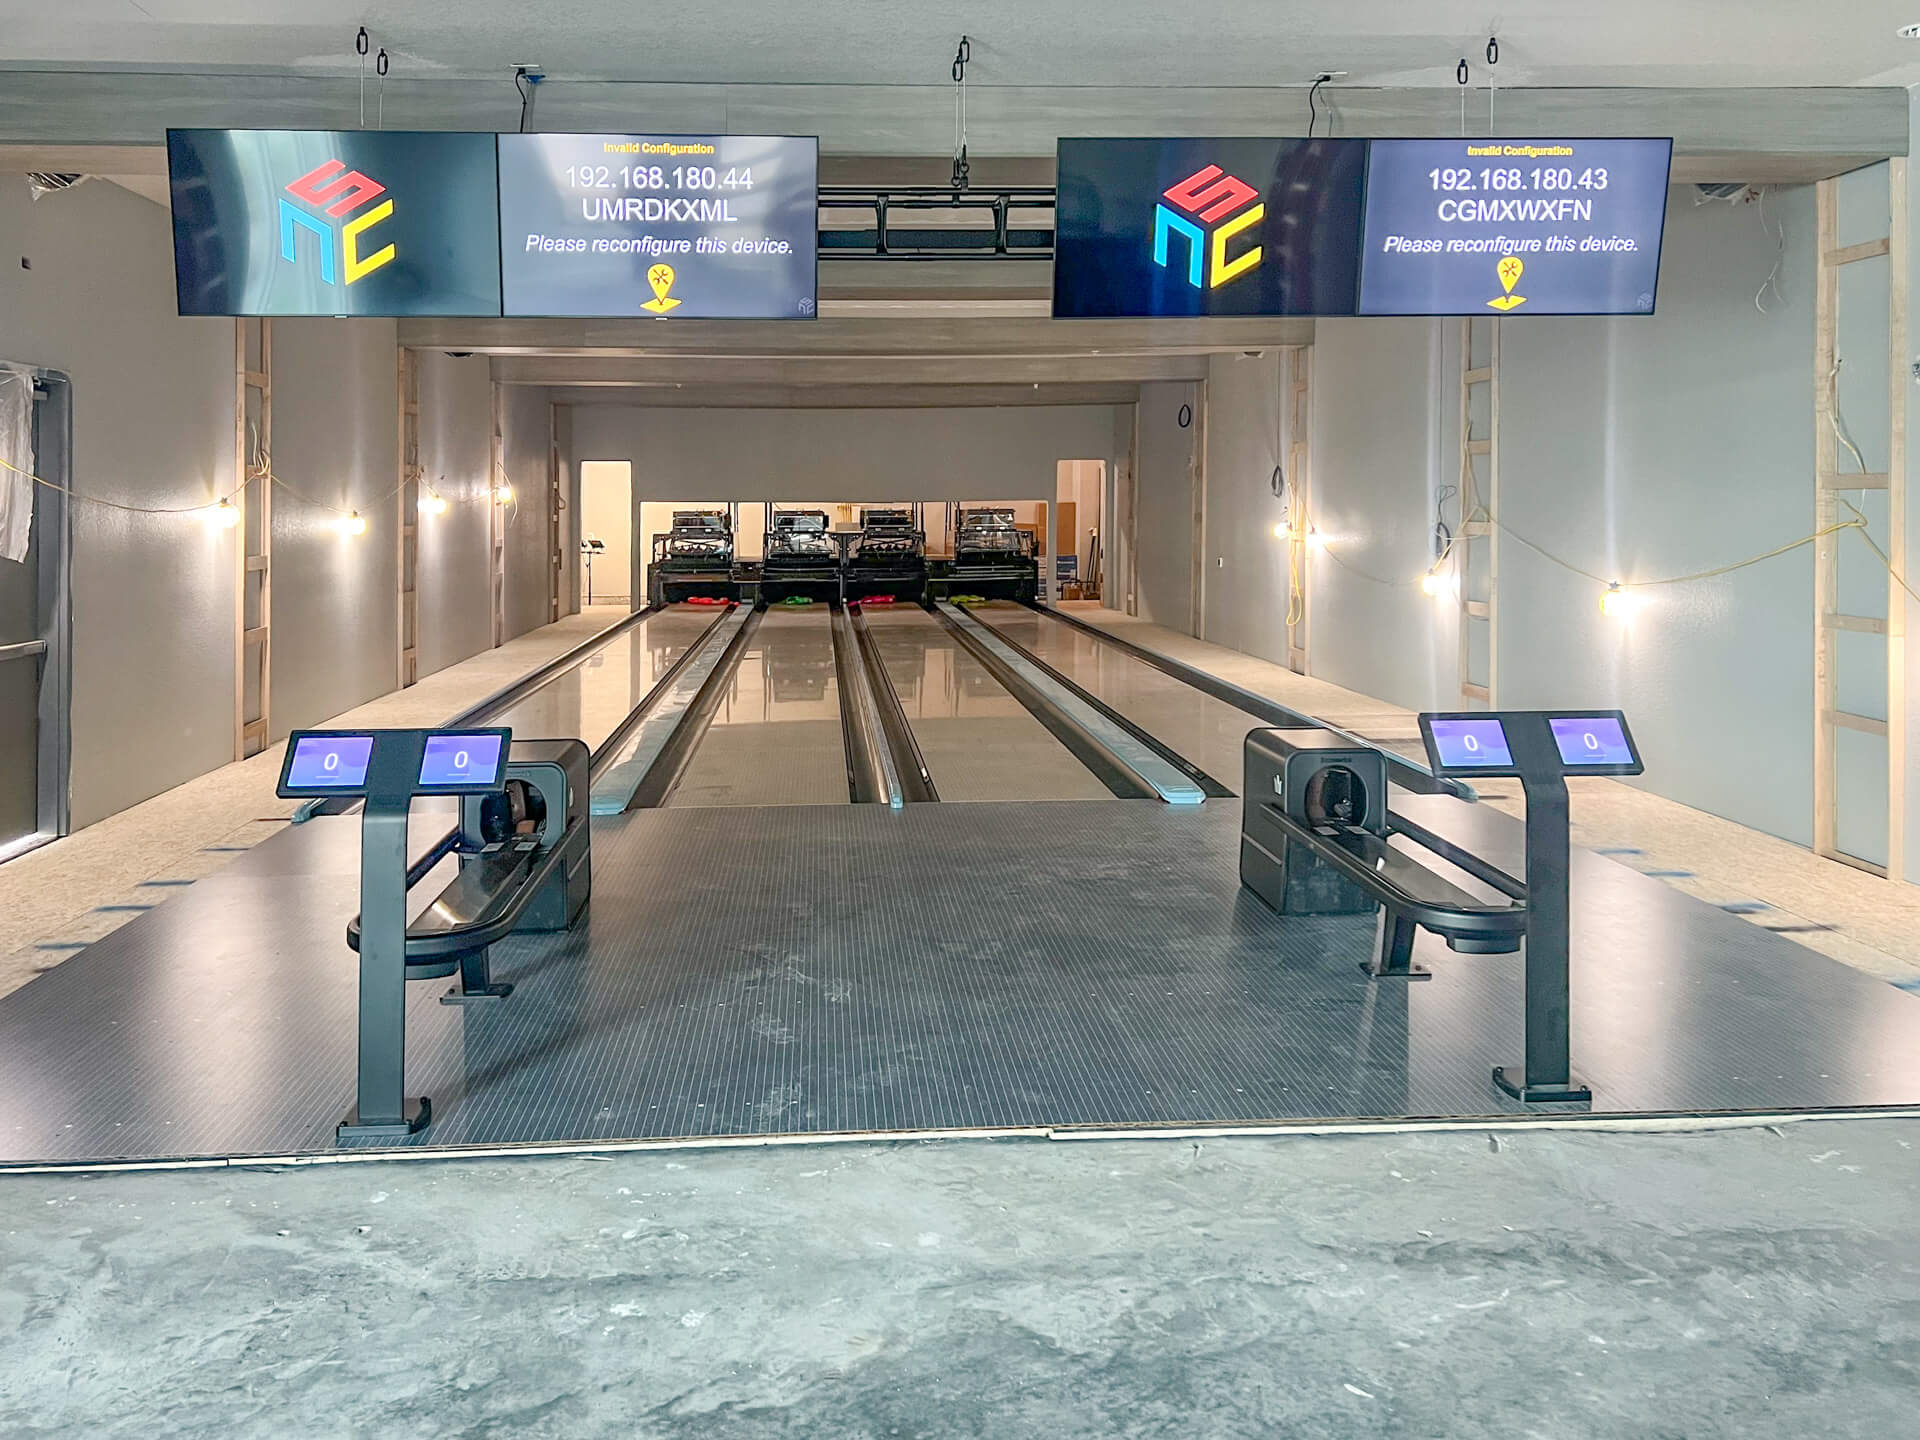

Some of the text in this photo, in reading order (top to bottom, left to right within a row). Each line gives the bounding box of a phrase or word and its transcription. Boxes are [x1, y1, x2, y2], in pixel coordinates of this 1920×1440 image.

[603, 142, 715, 156] Invalid Configuration
[1467, 145, 1573, 158] Invalid Configuration
[565, 166, 753, 190] 192.168.180.44
[1428, 168, 1609, 191] 192.168.180.43
[582, 197, 738, 222] UMRDKXML
[1437, 199, 1592, 222] CGMXWXFN
[525, 234, 793, 257] Please reconfigure this device.
[1384, 235, 1639, 256] Please reconfigure this device.
[1463, 734, 1479, 752] 0
[1583, 732, 1598, 750] 0
[323, 752, 339, 771] 0
[454, 750, 469, 769] 0
